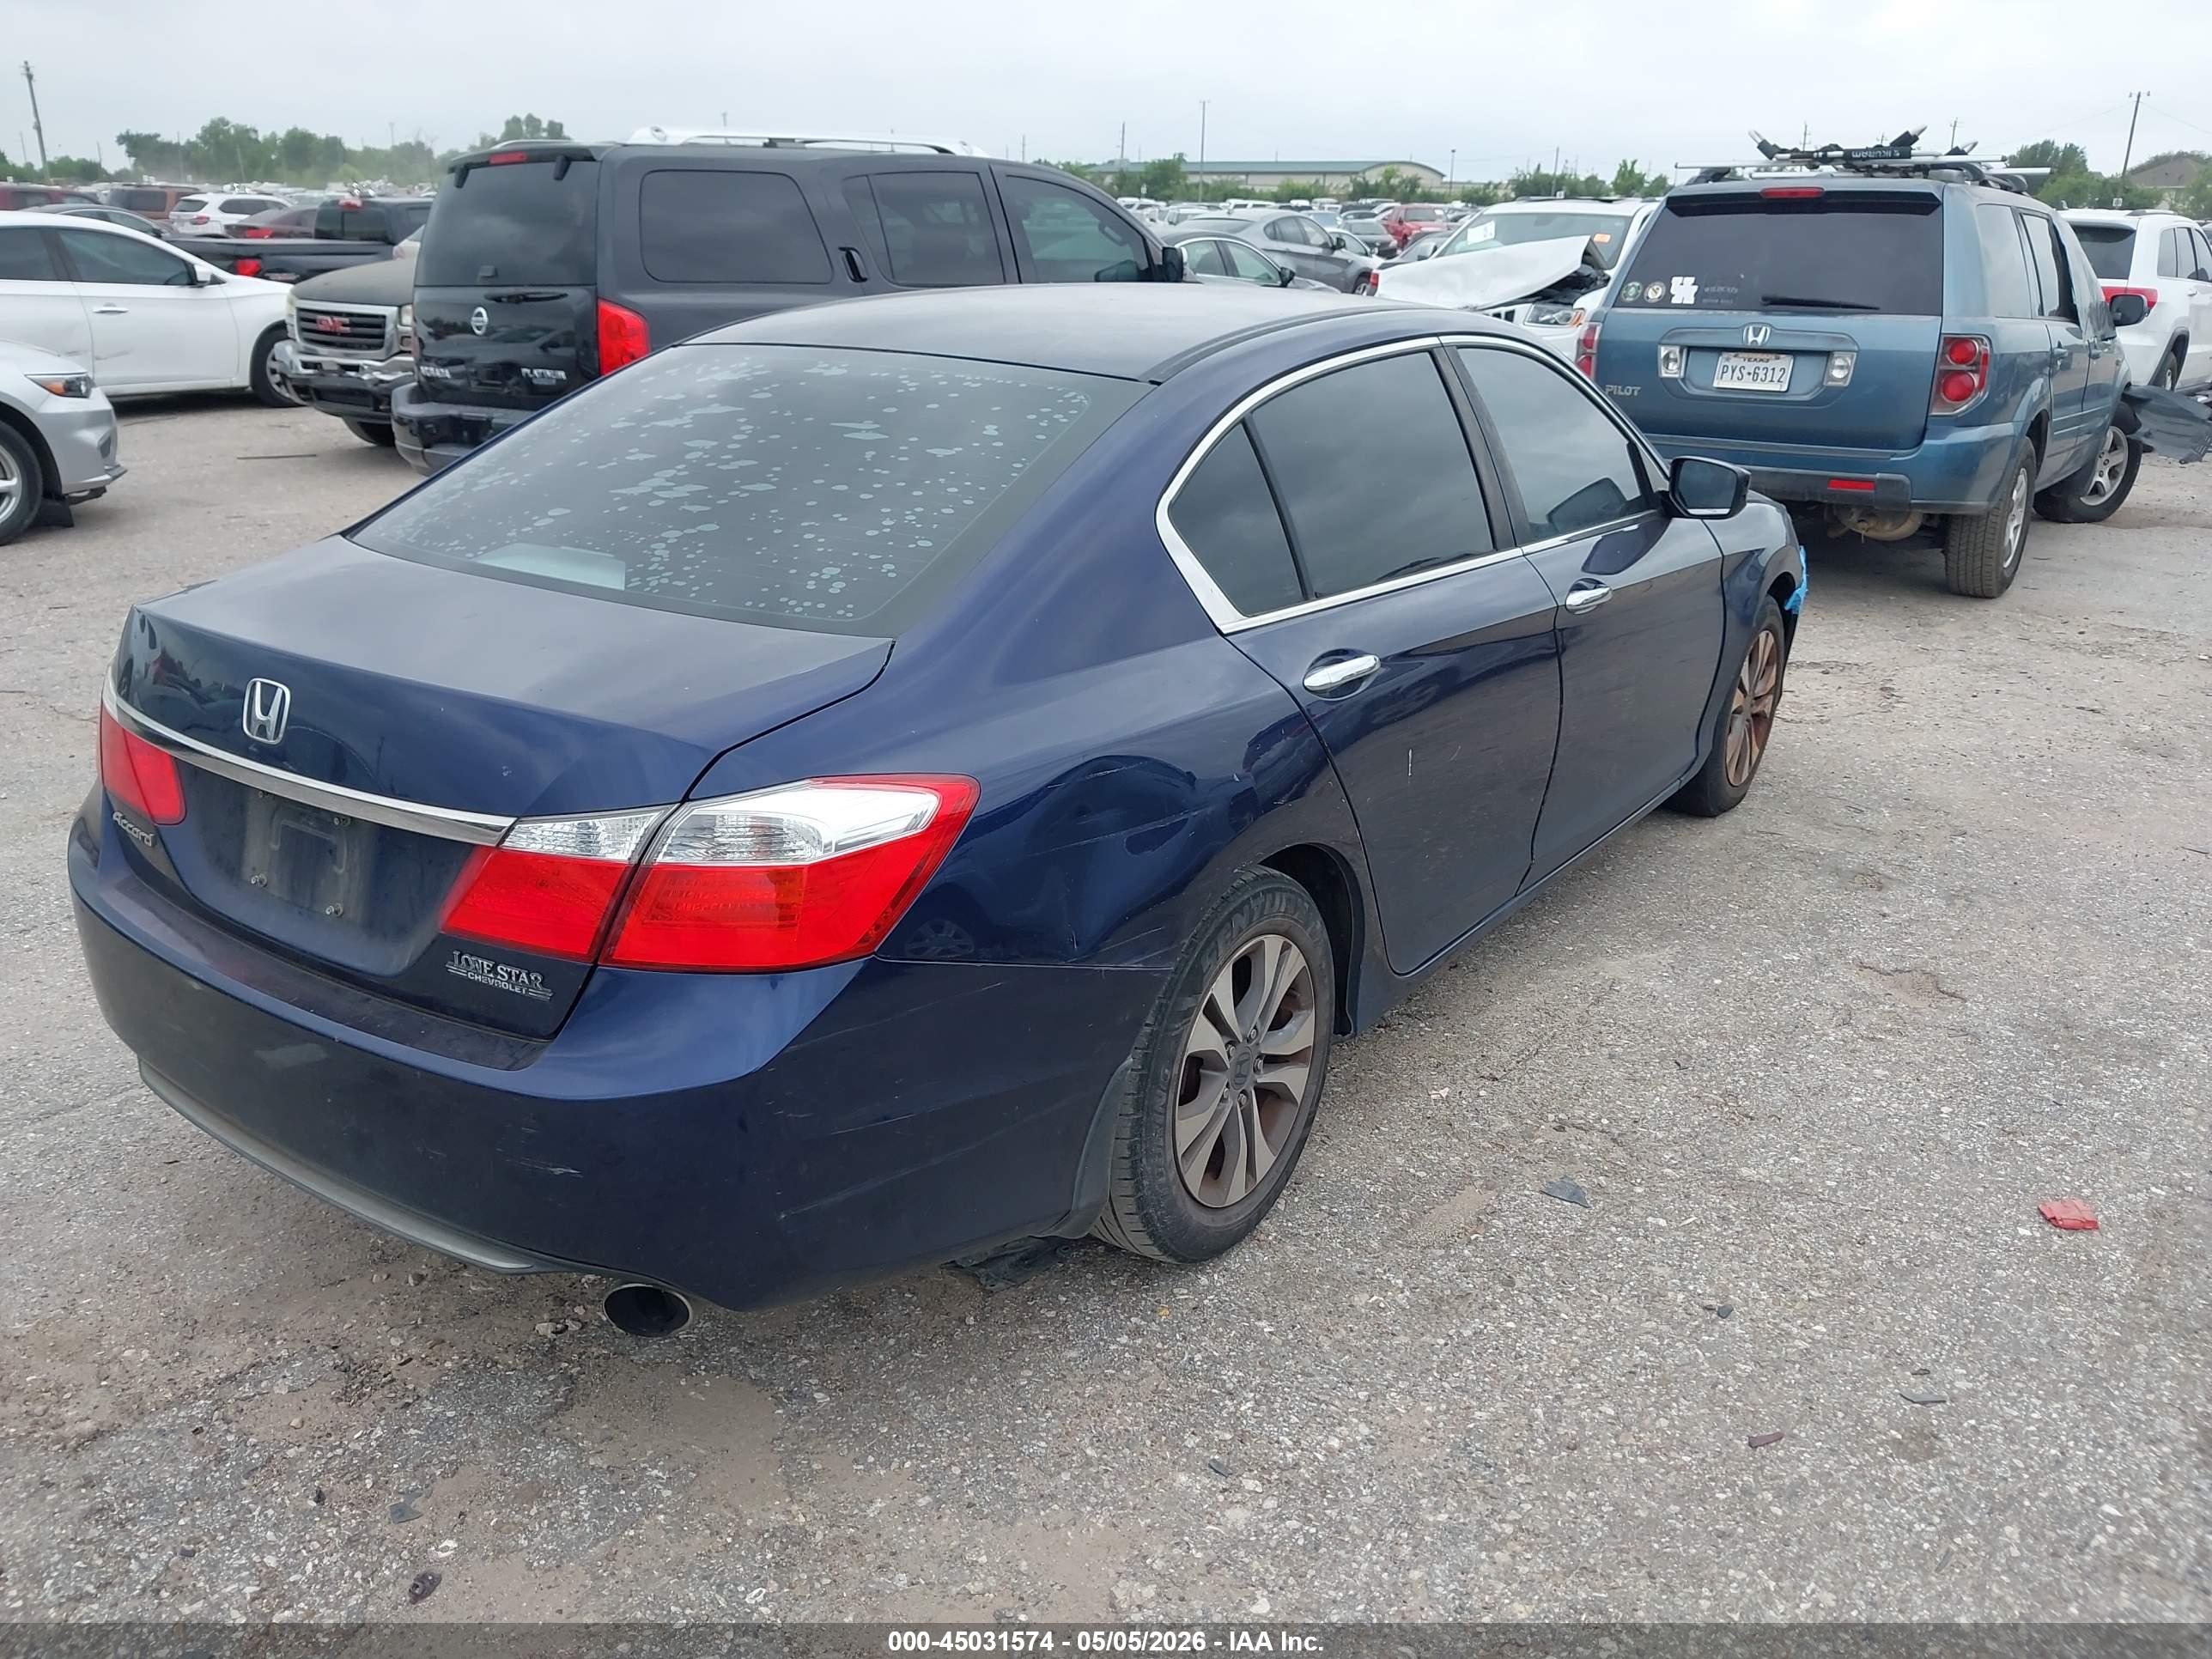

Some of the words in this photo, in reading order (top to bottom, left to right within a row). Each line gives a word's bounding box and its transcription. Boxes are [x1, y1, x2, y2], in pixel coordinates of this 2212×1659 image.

[1605, 384, 1642, 396] PILOT
[112, 811, 155, 848] Accord
[452, 949, 495, 978] LONE
[496, 963, 544, 992] STAR
[467, 971, 528, 995] CHEVROLET
